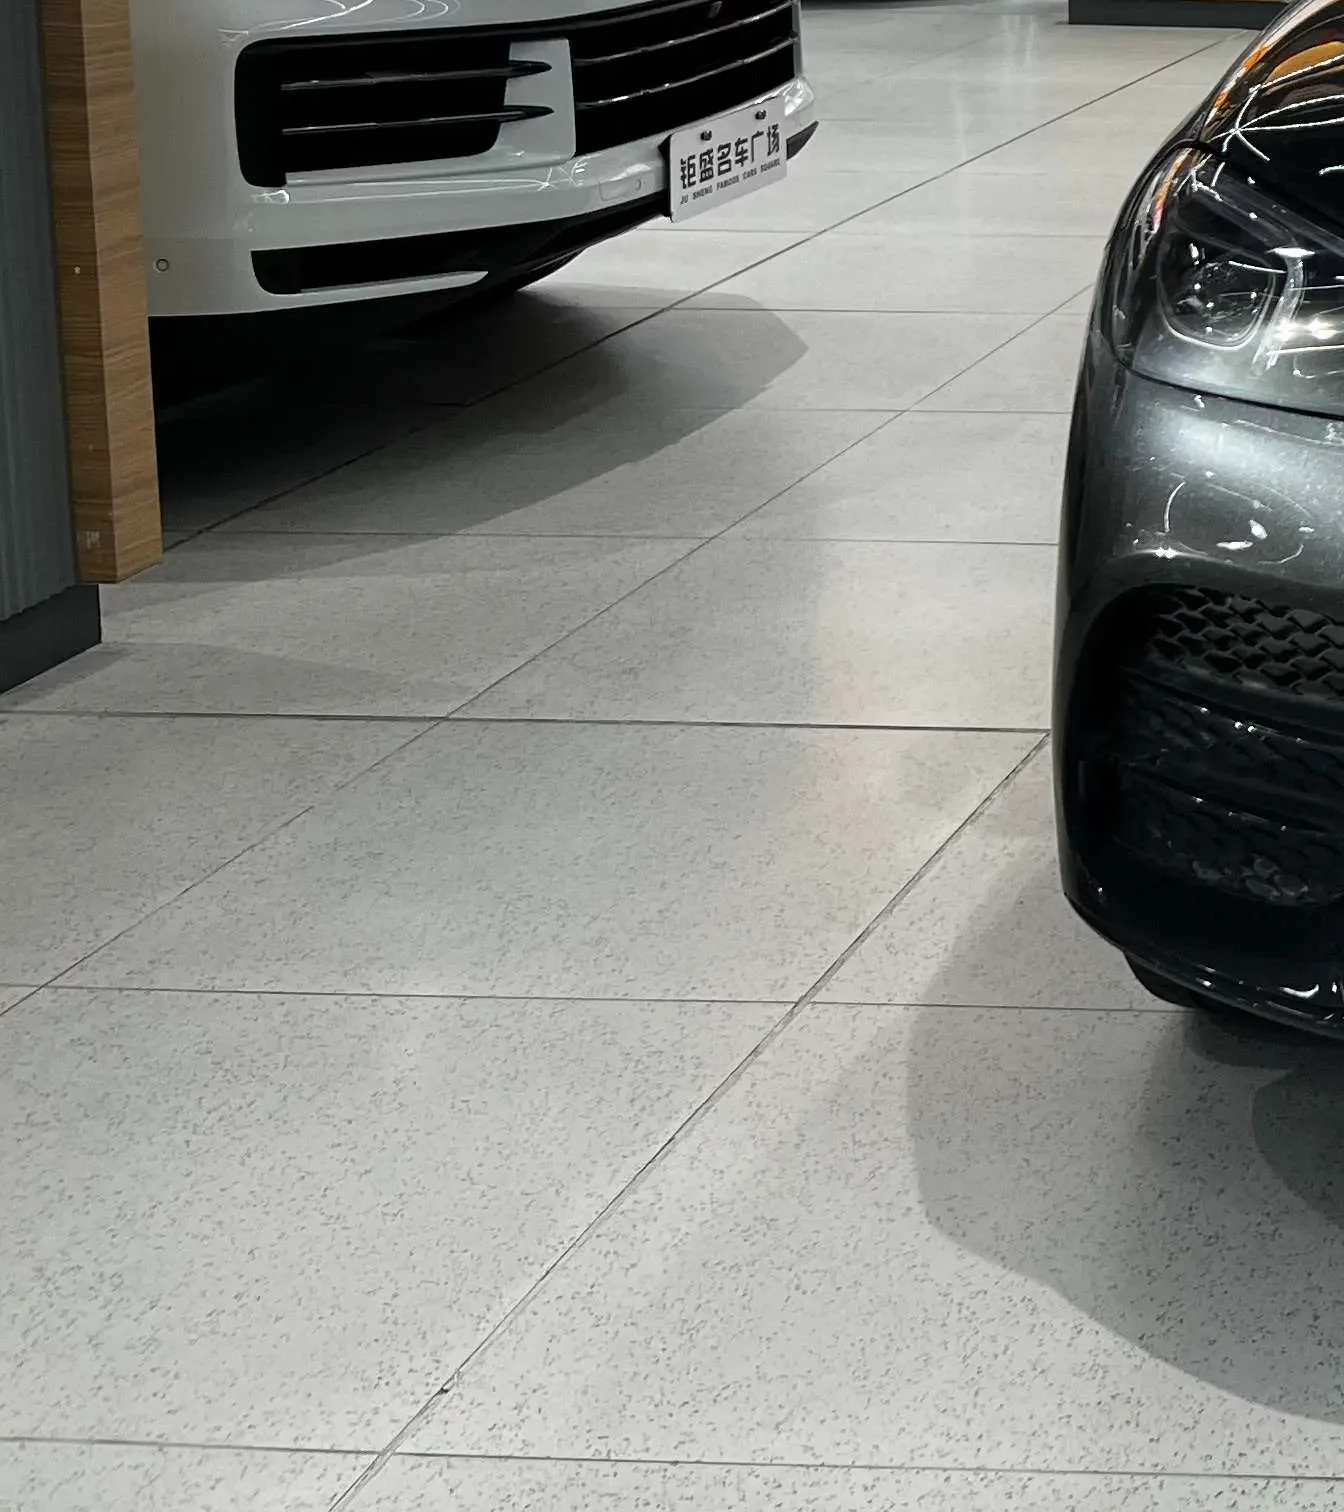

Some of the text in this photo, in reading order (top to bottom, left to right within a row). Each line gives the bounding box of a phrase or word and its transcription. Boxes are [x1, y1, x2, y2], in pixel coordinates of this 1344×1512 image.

[680, 123, 780, 189] 钜盛名车广场
